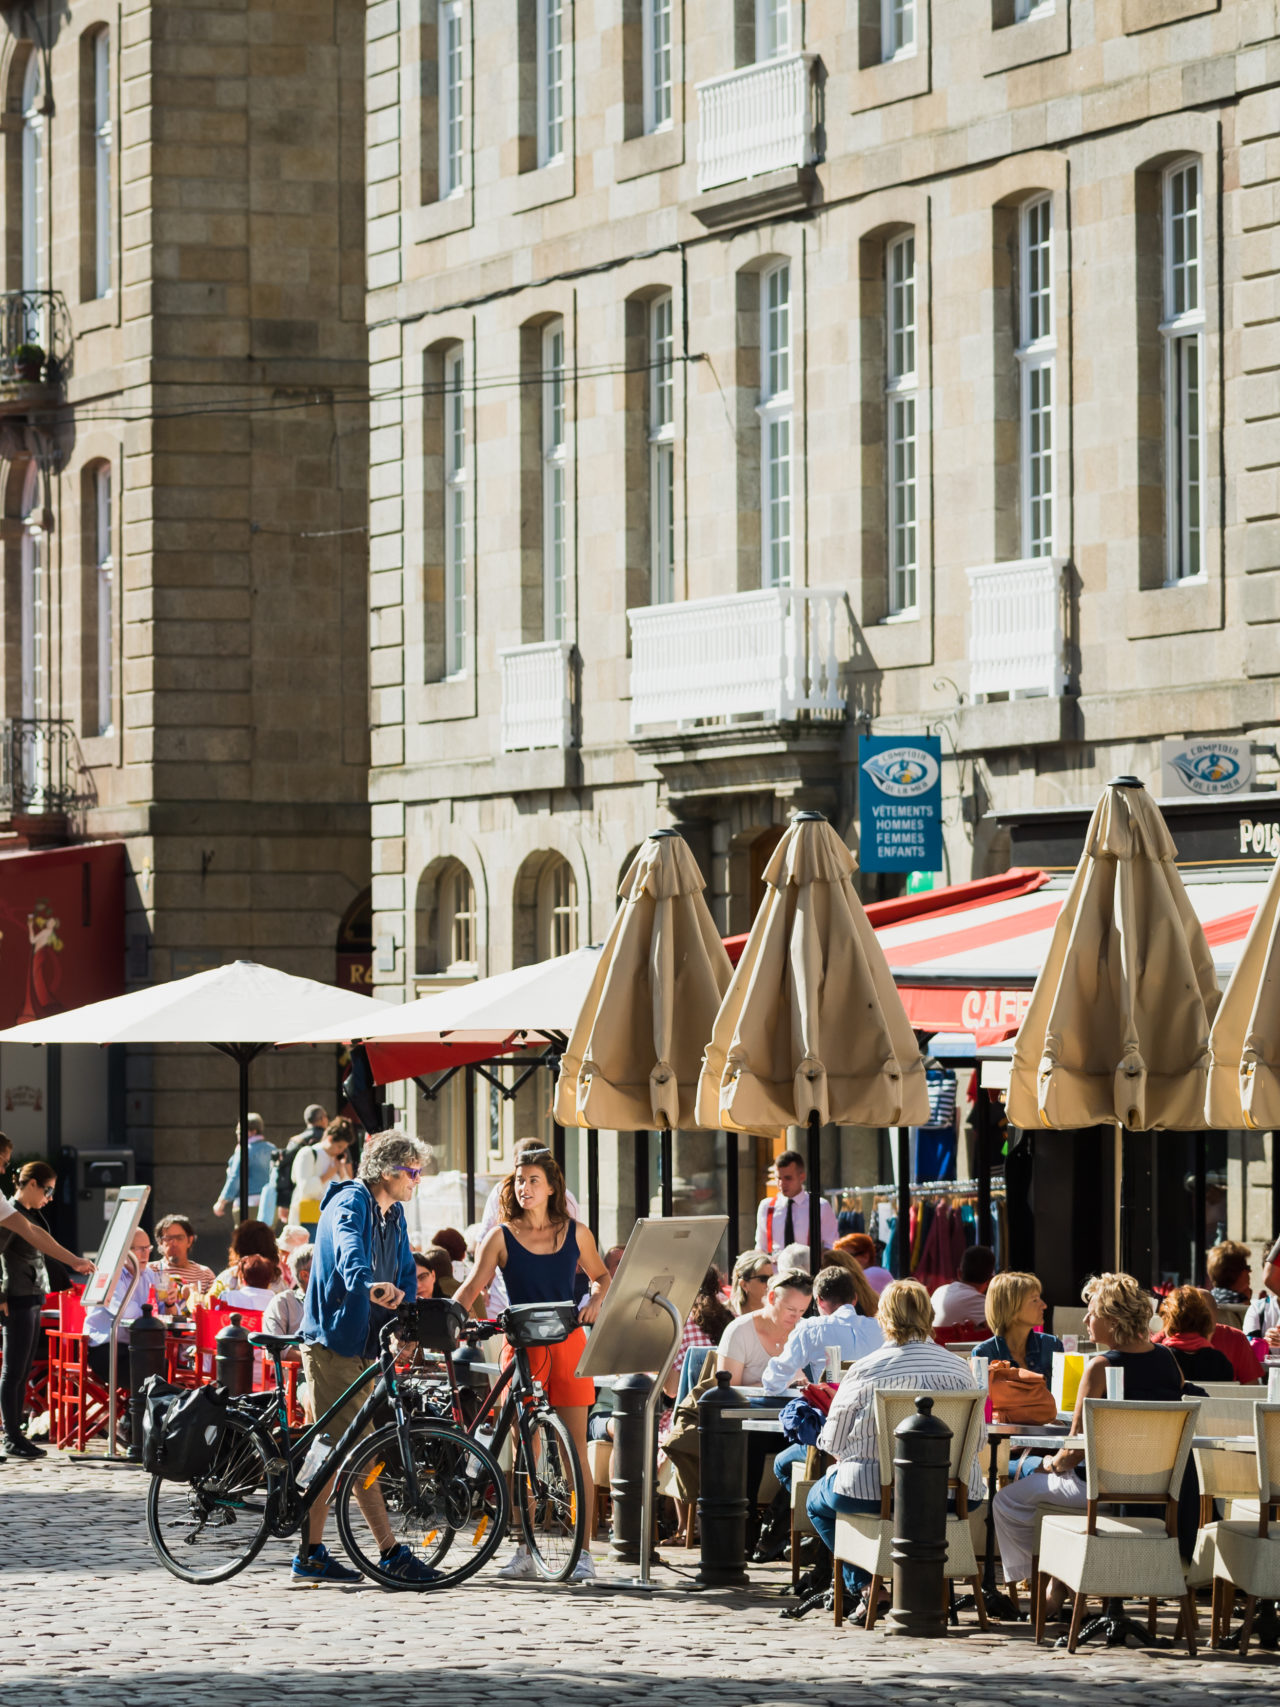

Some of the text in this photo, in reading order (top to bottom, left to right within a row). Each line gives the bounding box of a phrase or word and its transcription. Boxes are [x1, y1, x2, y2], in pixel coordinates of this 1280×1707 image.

[876, 819, 924, 831] HOMMES
[876, 832, 925, 844] FEMMES
[878, 846, 926, 858] ENFANTS
